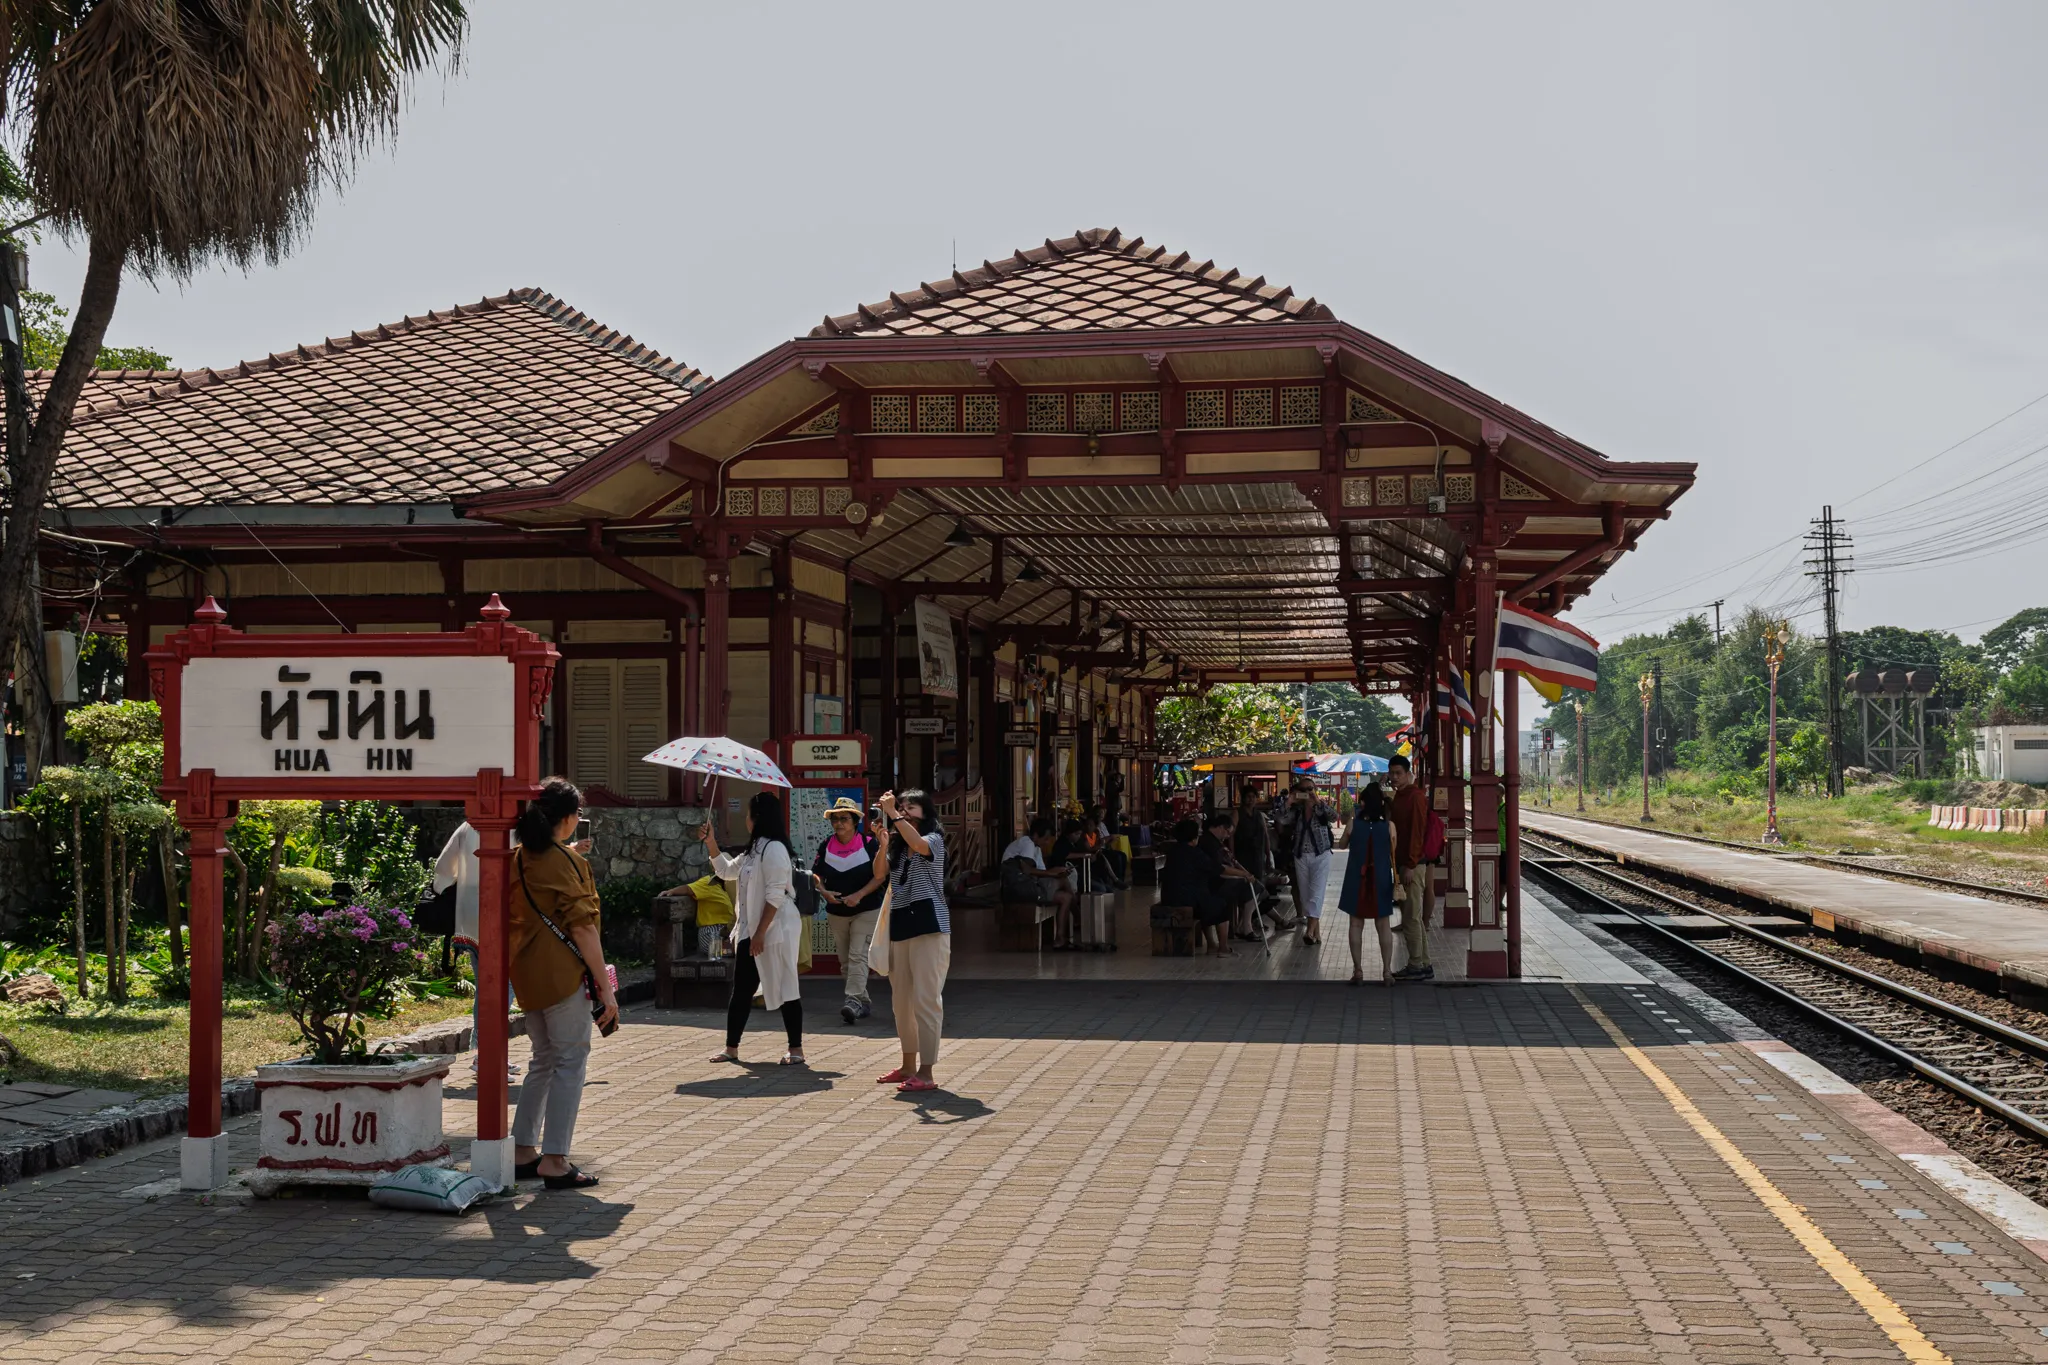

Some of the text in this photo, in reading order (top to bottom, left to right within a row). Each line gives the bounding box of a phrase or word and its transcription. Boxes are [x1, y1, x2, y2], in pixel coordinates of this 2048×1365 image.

[261, 665, 435, 740] หัวหิน
[275, 748, 413, 771] HUA HIN
[812, 745, 840, 754] OTOP
[551, 924, 566, 940] YOUNG
[279, 1102, 377, 1148] ร.ฟ.ท
